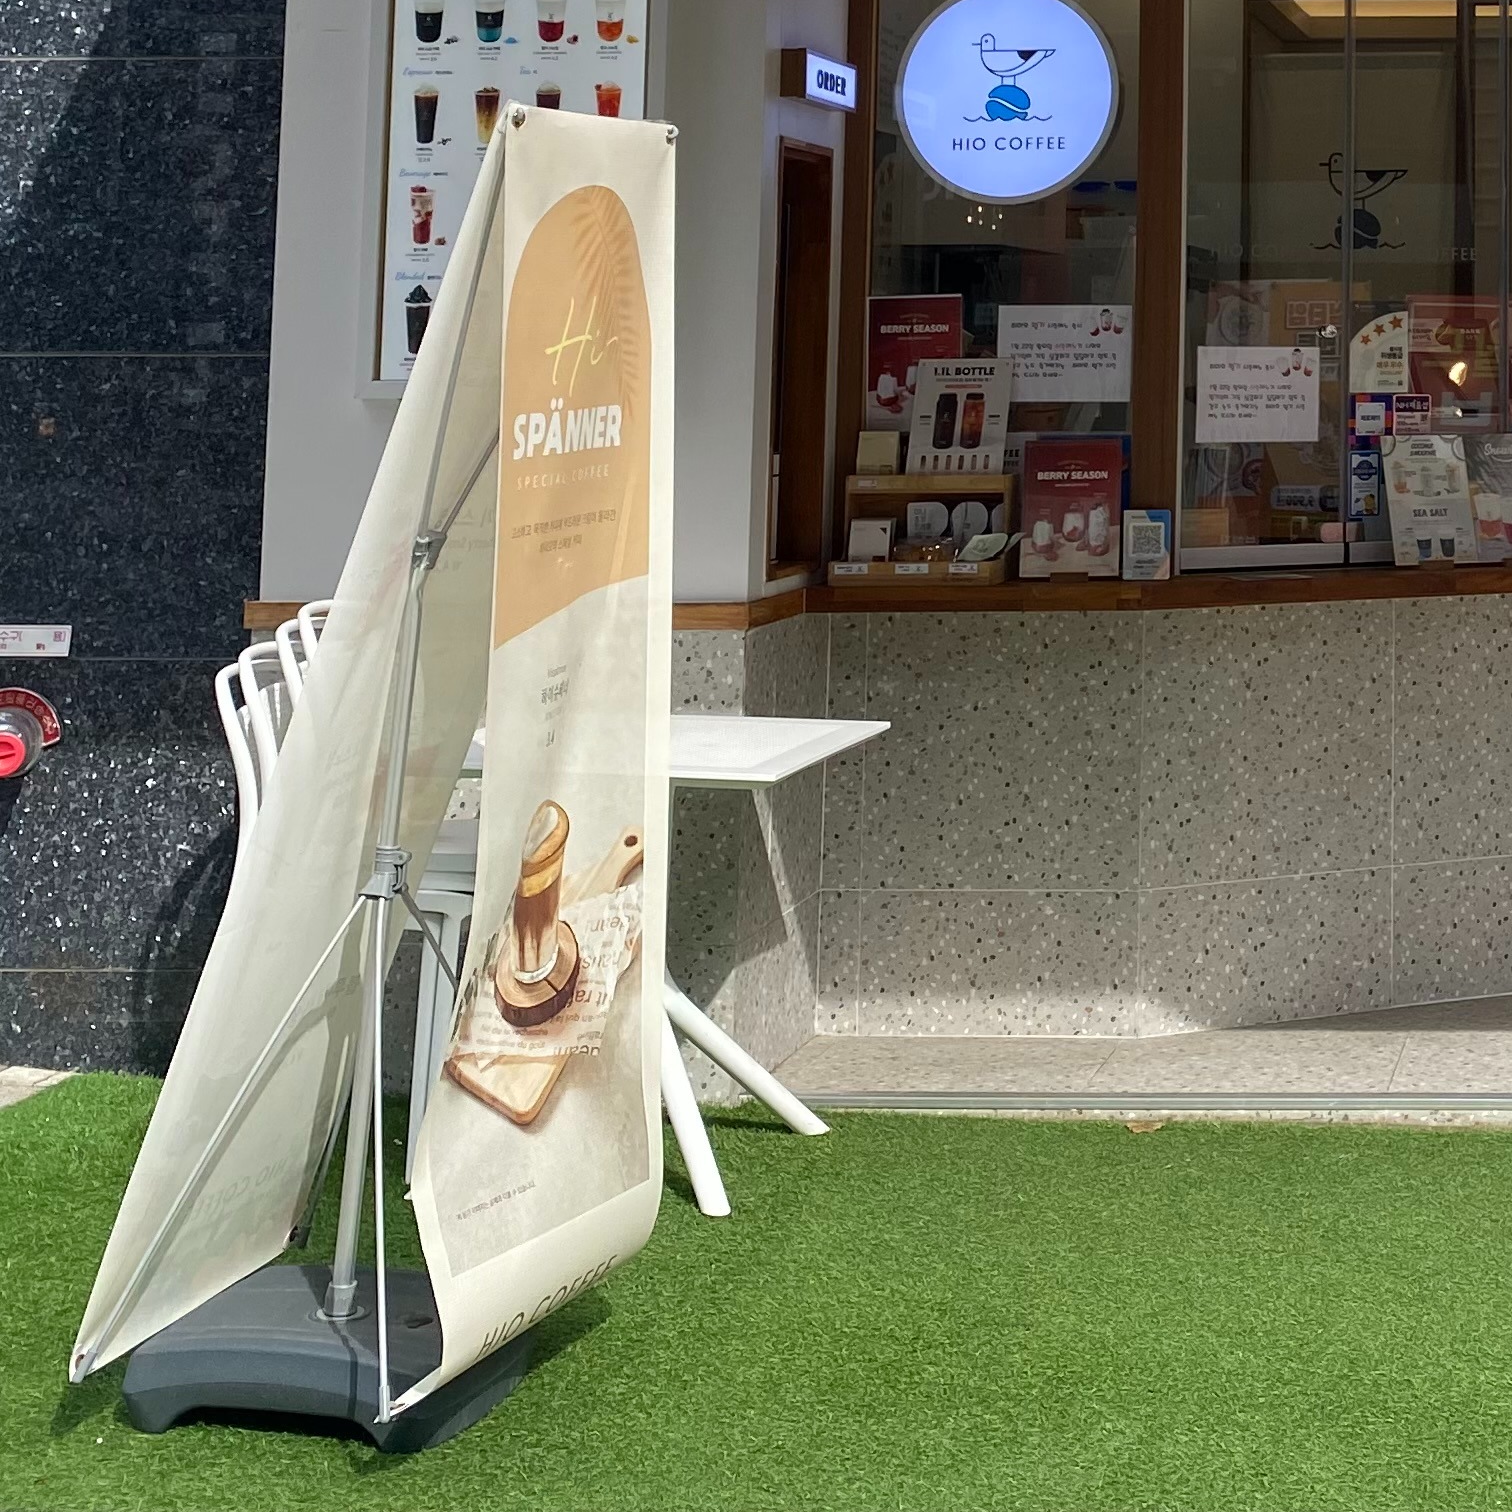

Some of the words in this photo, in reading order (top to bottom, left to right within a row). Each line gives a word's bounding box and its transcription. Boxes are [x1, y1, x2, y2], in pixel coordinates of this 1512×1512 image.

[815, 68, 847, 97] ORDER
[952, 136, 987, 152] HIO
[993, 135, 1066, 152] COFFEE
[880, 324, 911, 334] BERRY
[913, 323, 950, 334] SEASON
[954, 366, 996, 377] BOTTLE
[513, 397, 623, 461] SPÄNNER
[517, 470, 568, 491] SPECIAL
[1037, 470, 1070, 481] BERRY
[1071, 469, 1109, 481] SEASON
[1412, 508, 1430, 518] SEA
